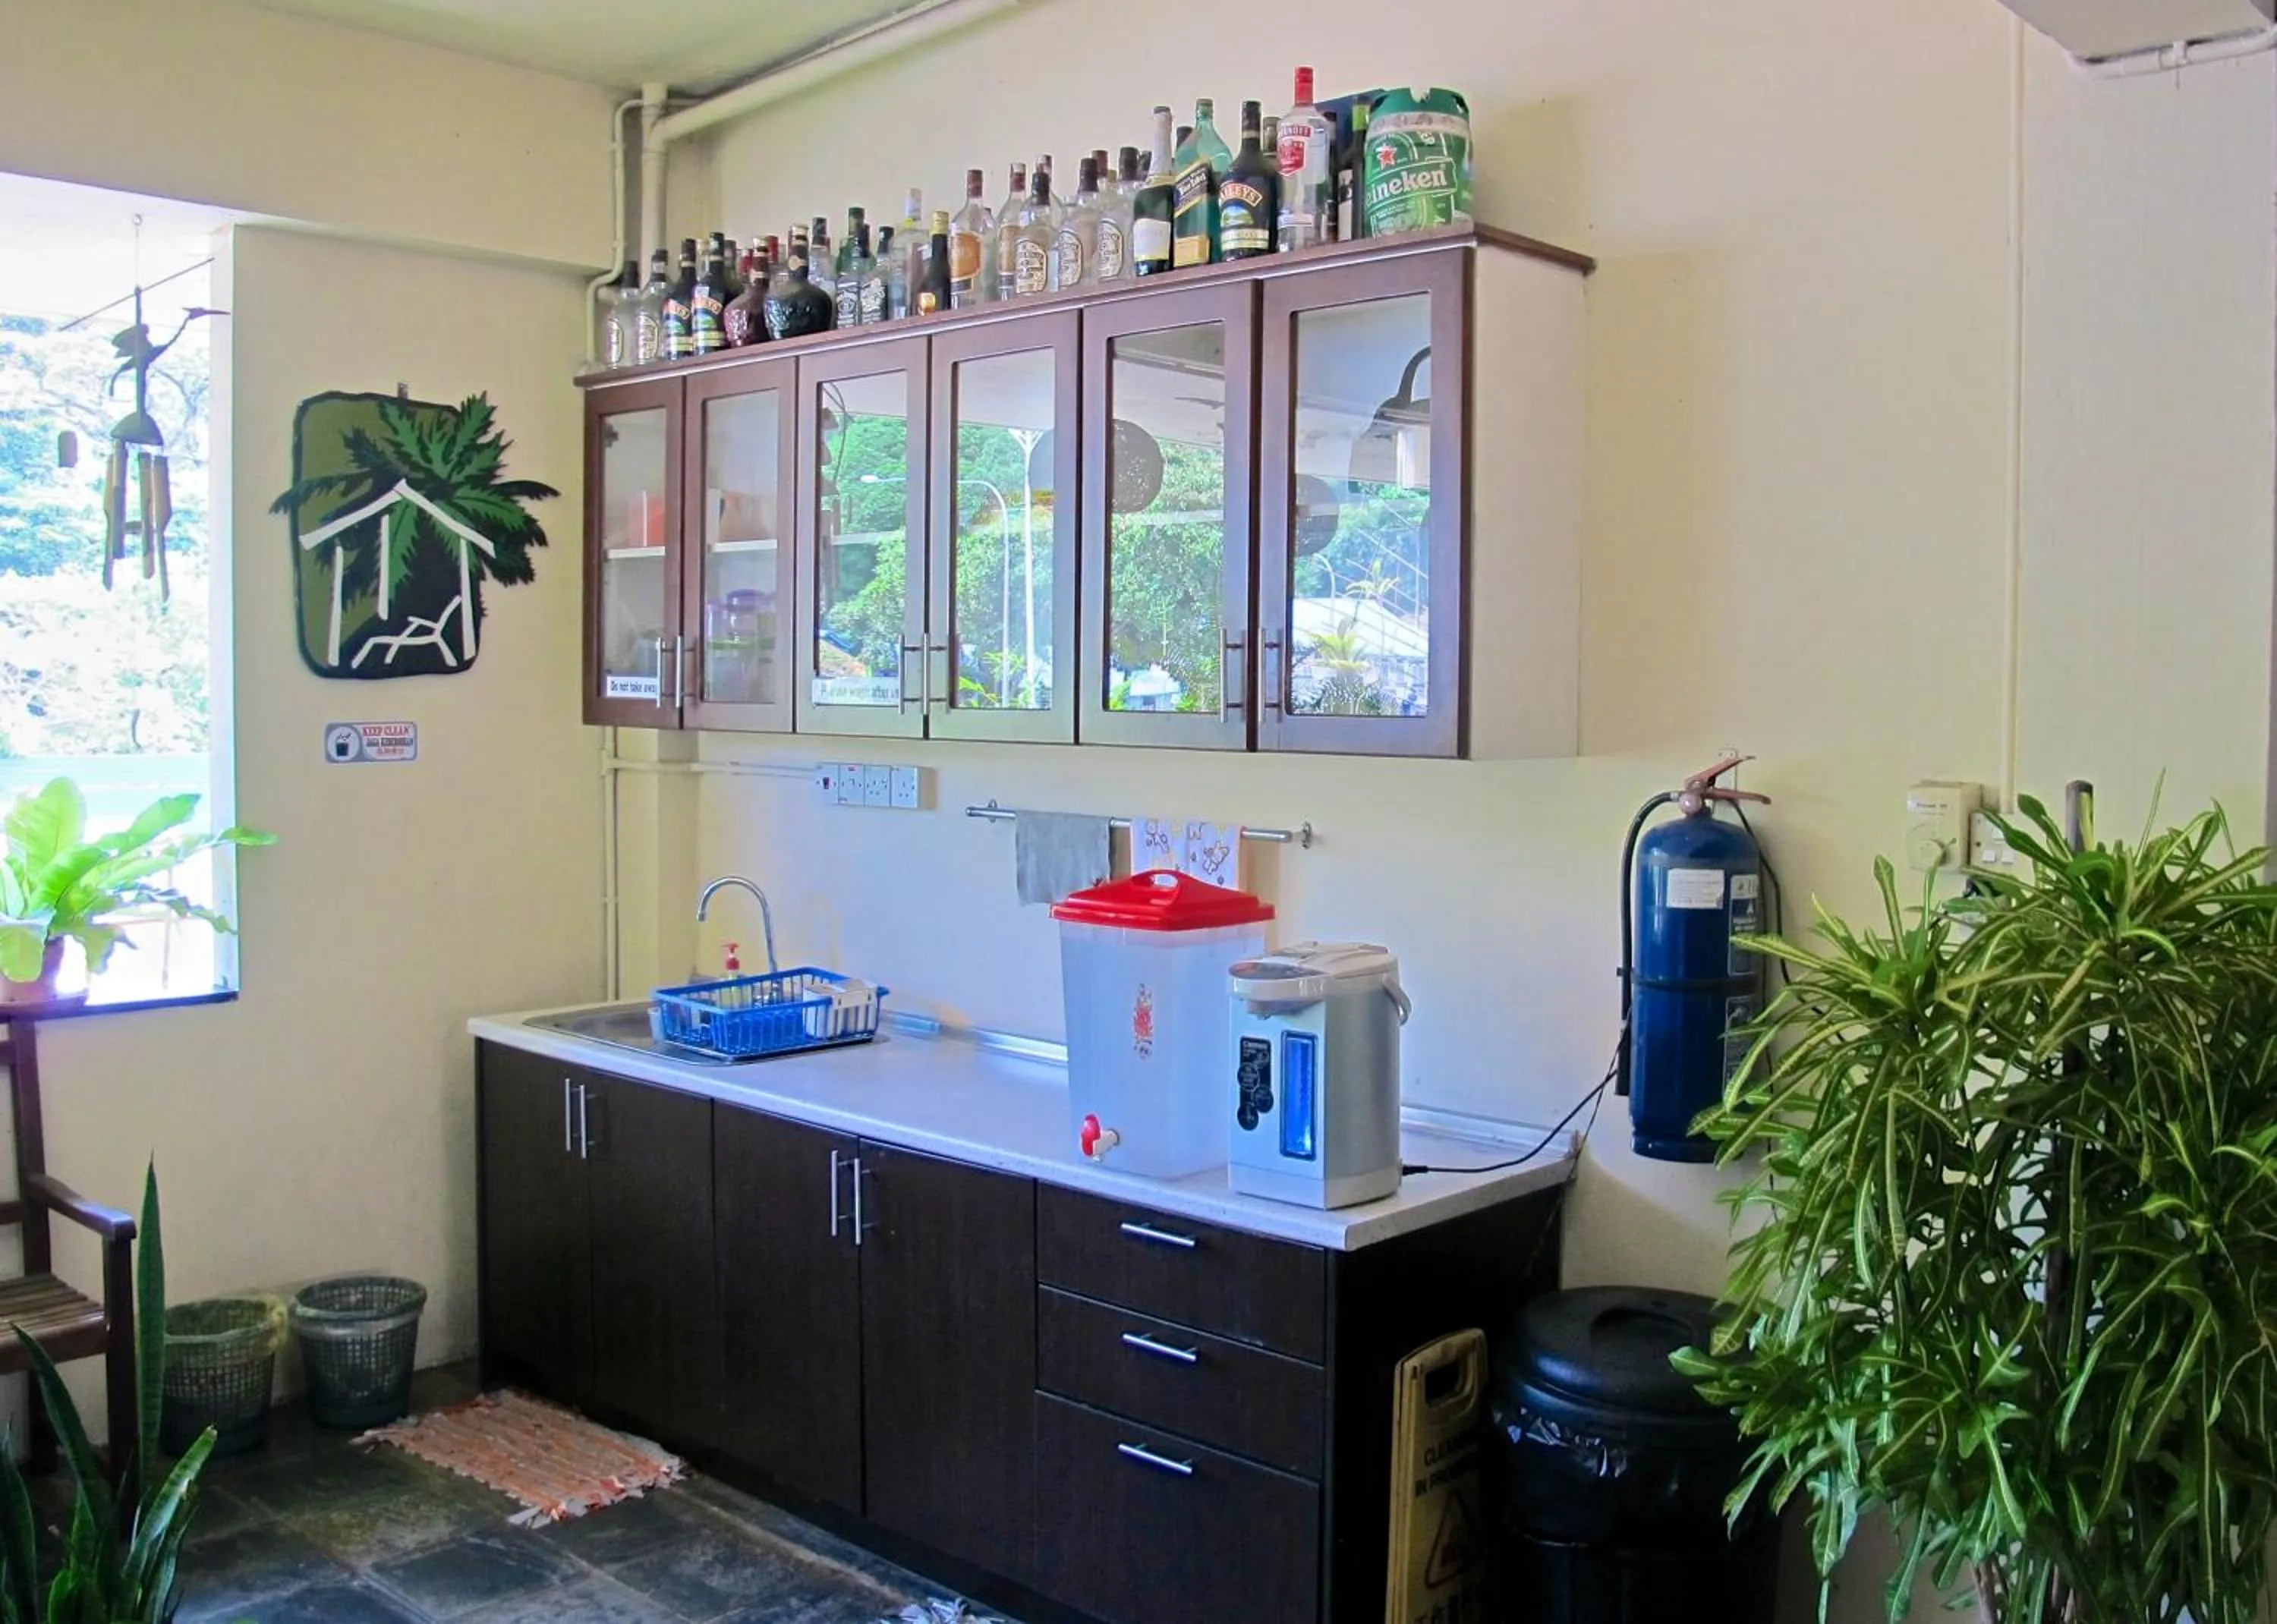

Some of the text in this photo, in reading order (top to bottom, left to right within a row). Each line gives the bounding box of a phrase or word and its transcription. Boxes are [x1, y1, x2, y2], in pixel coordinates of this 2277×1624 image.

[1366, 168, 1447, 206] eineken
[619, 682, 628, 691] not
[630, 681, 643, 693] take
[644, 684, 657, 693] awa
[363, 725, 409, 736] KEEP CLEAN
